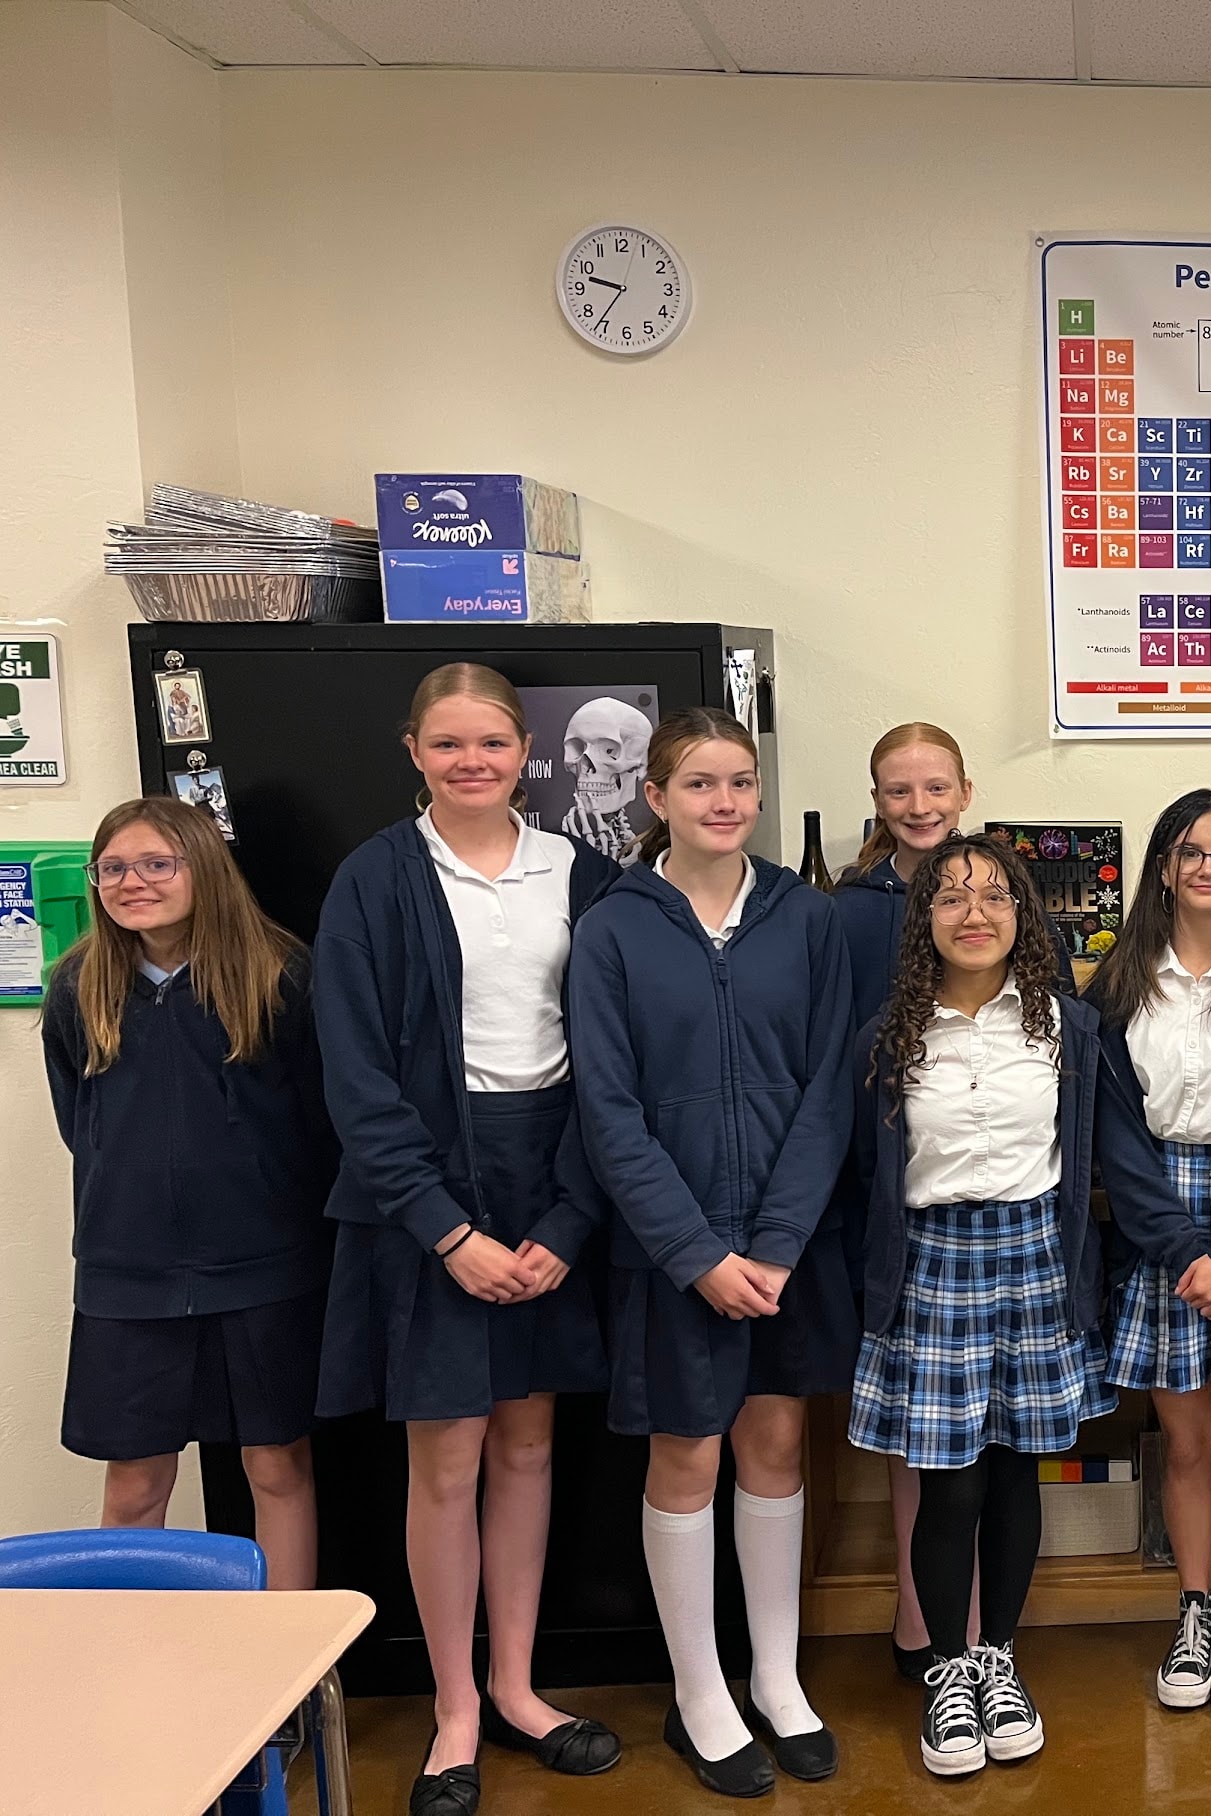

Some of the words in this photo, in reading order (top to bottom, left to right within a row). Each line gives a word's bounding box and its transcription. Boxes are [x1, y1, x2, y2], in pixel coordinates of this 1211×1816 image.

[597, 244, 603, 257] 11
[615, 239, 629, 252] 12
[642, 244, 645, 258] 1
[580, 260, 594, 274] 10
[655, 260, 665, 274] 2
[575, 281, 585, 296] 9
[663, 283, 673, 296] 3
[583, 304, 593, 317] 8
[658, 305, 668, 318] 4
[1071, 310, 1081, 324] H
[600, 320, 609, 333] 7
[643, 321, 653, 335] 5
[1152, 321, 1180, 329] Atomic
[622, 327, 632, 340] 6
[1152, 330, 1184, 339] number
[1203, 326, 1211, 340] 8
[1070, 350, 1084, 364] Li
[1106, 350, 1126, 364] Be
[1067, 388, 1088, 402] Na
[1105, 388, 1129, 406] Mg
[1073, 428, 1084, 442] K
[1107, 428, 1127, 442] Ca
[1146, 428, 1165, 443] Sc
[1186, 428, 1201, 442] Ti
[1185, 467, 1203, 482] Zr
[1140, 498, 1161, 506] 57-71
[1179, 498, 1187, 506] 72
[433, 512, 450, 520] soft
[450, 512, 470, 520] ultra
[1108, 505, 1128, 520] Ba
[412, 519, 493, 548] Kleenex
[1140, 536, 1167, 545] 89-103
[1179, 536, 1193, 544] 104
[1072, 544, 1088, 559] Fr
[443, 596, 522, 615] Everyday
[1148, 605, 1166, 619] La
[1185, 643, 1204, 657] Th
[1096, 683, 1117, 692] Alkali
[1117, 683, 1138, 692] metal
[1153, 704, 1186, 712] Metalloid
[20, 763, 56, 775] CLEAR
[528, 759, 552, 779] NOW
[3, 891, 24, 899] FACE
